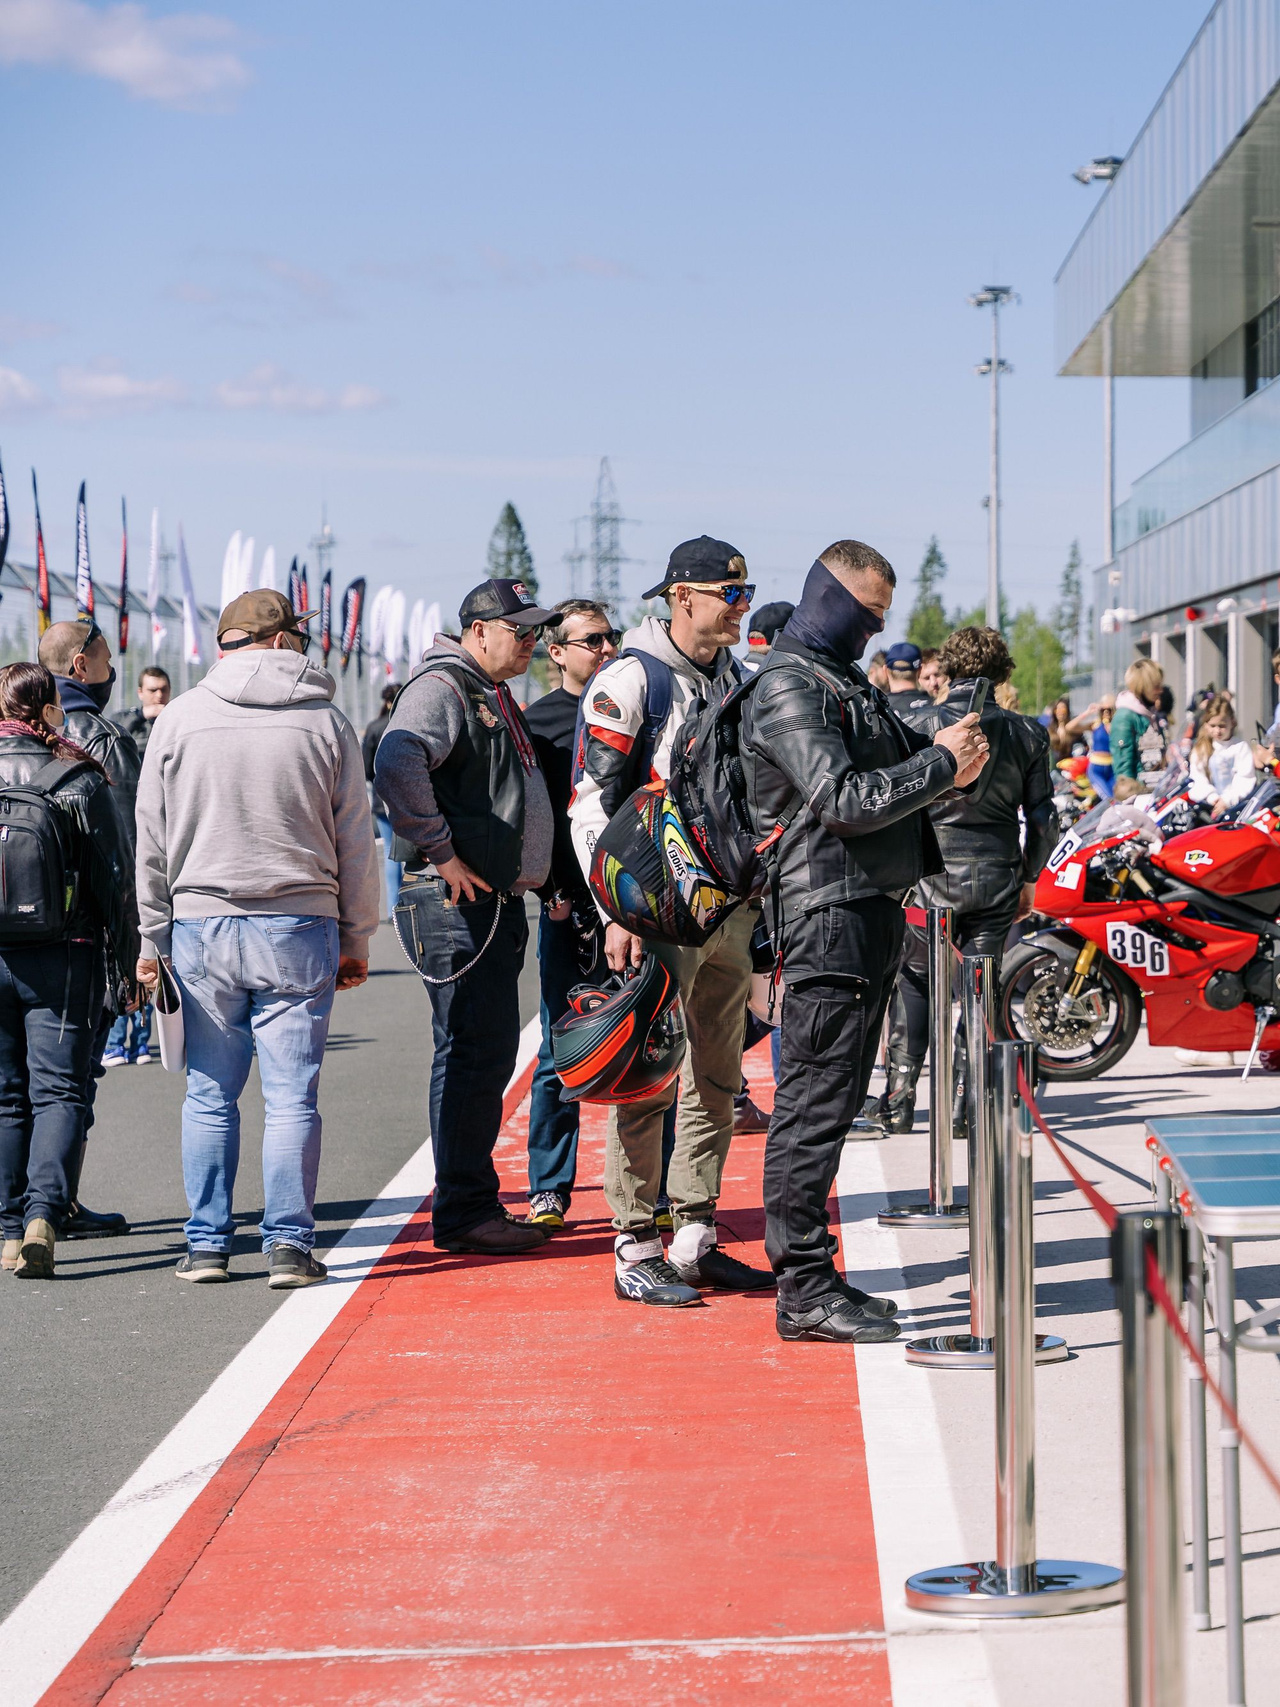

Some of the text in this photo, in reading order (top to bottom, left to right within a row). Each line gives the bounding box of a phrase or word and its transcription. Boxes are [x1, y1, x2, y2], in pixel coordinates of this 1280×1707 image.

[668, 849, 687, 877] SHOEI
[1050, 839, 1074, 868] 6
[1111, 928, 1165, 974] 396
